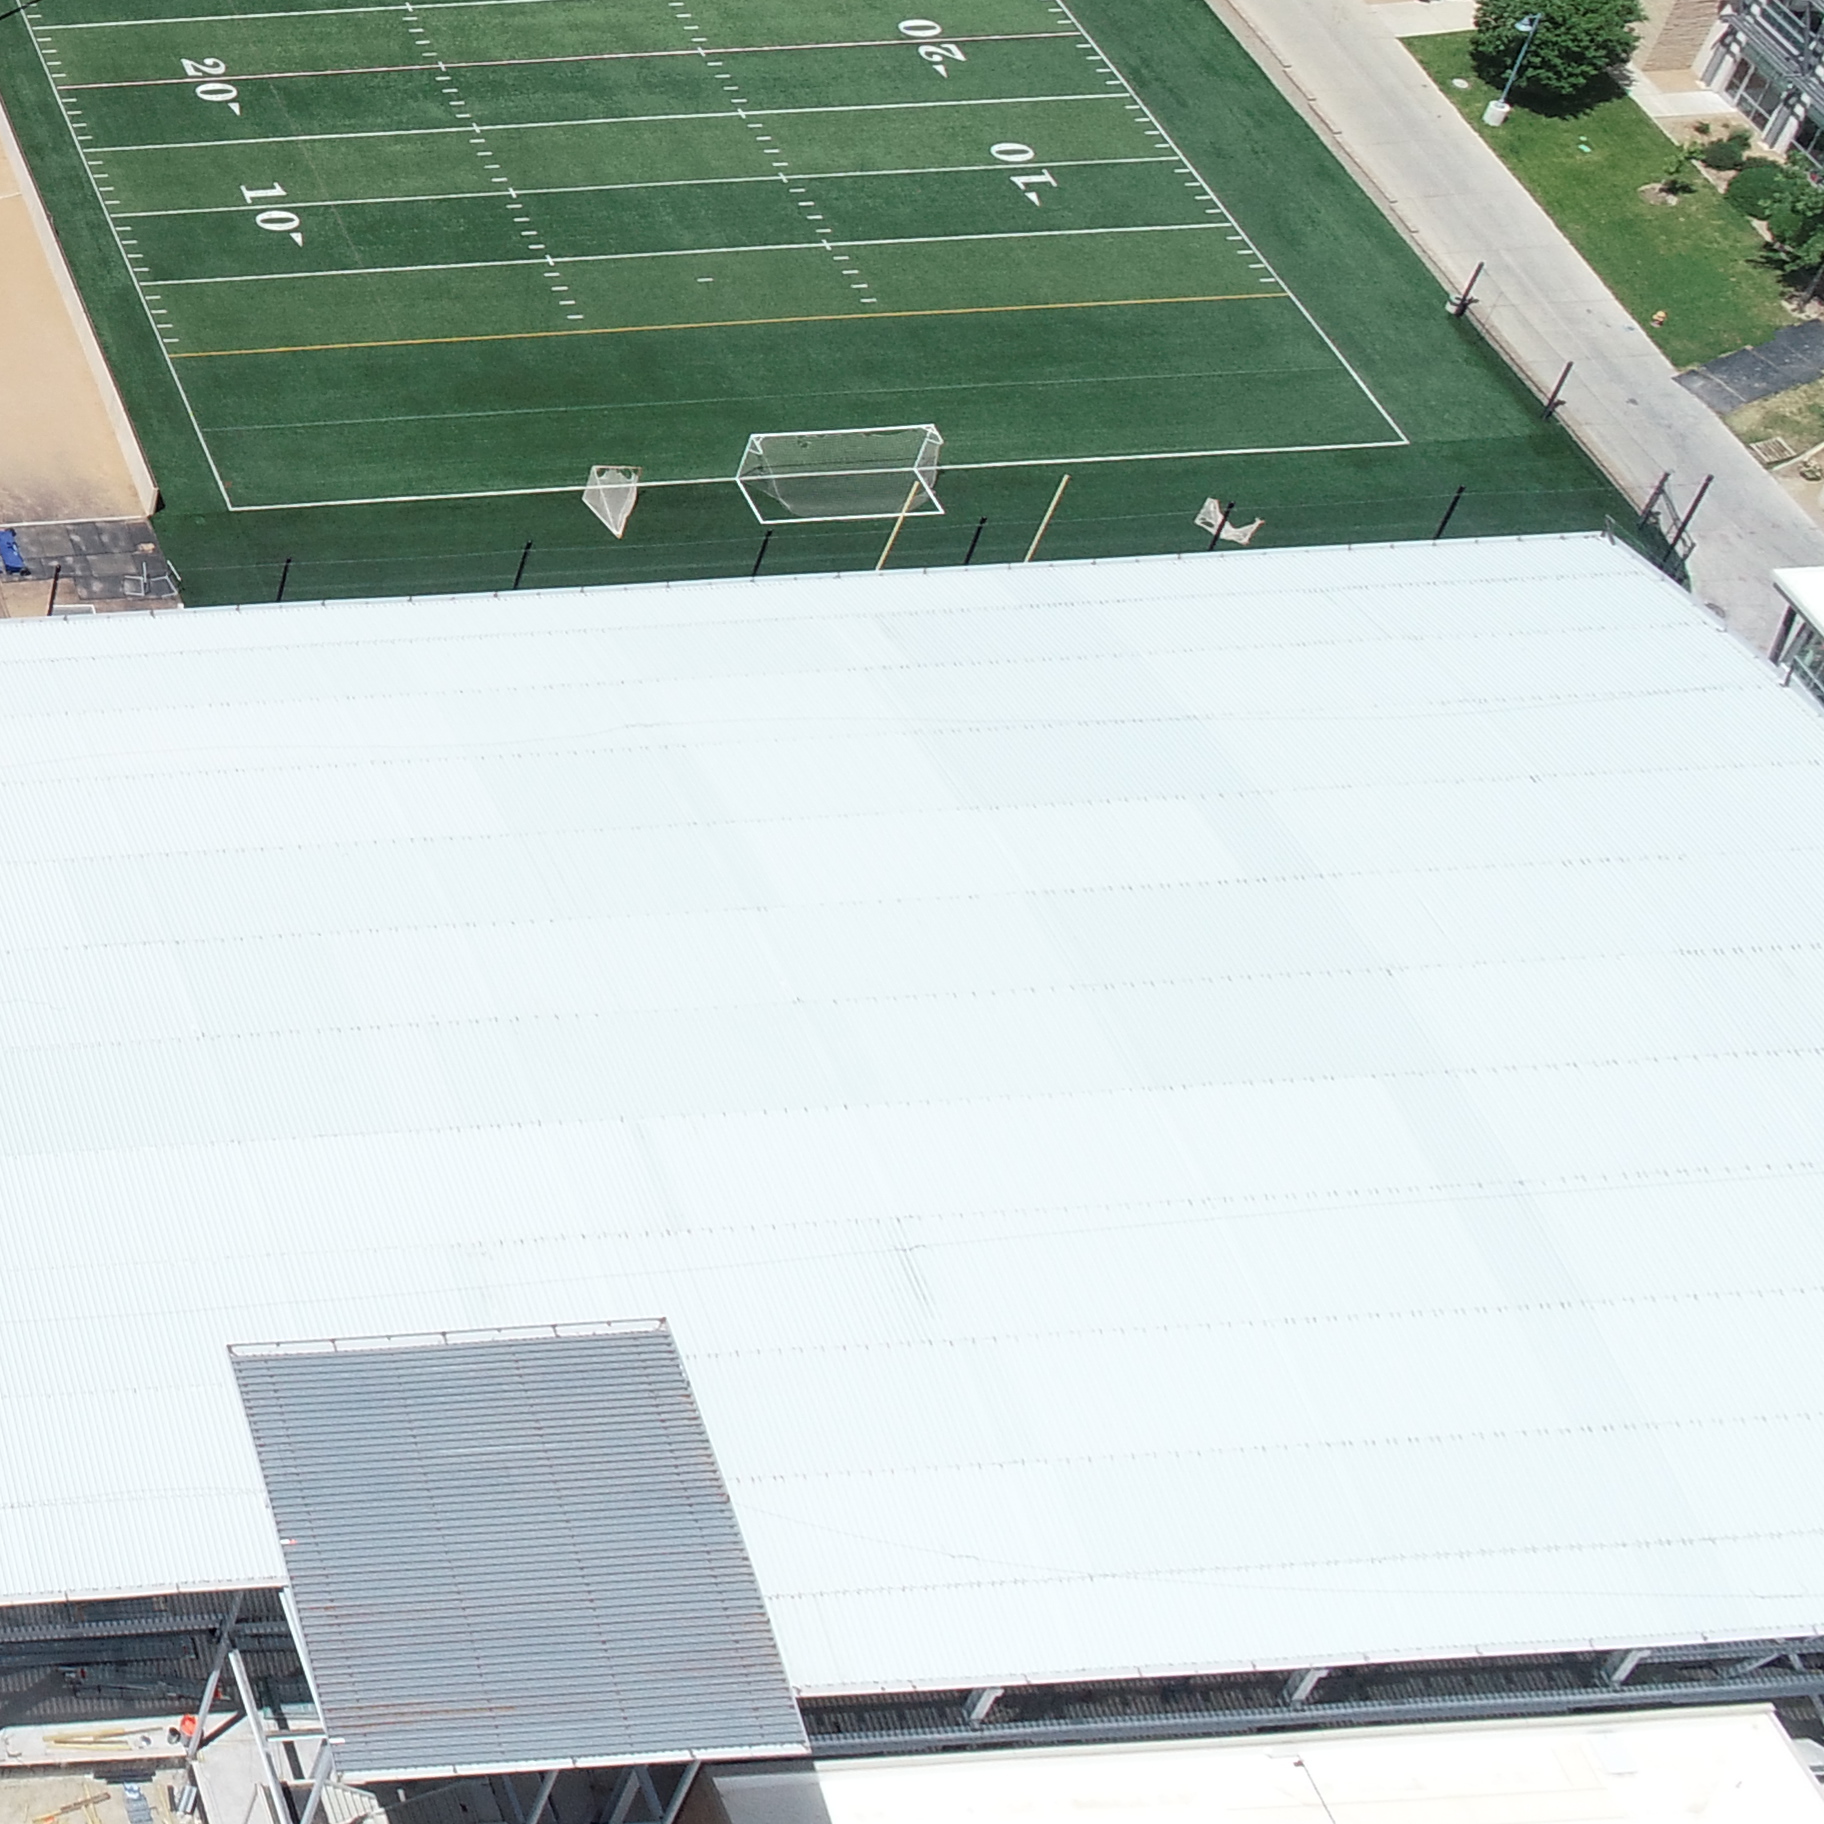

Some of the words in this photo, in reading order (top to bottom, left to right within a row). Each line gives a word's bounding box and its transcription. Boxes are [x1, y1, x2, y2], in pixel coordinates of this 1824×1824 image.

[898, 19, 967, 62] 20
[180, 57, 237, 102] 20
[990, 142, 1057, 190] 10
[240, 181, 300, 231] 10
